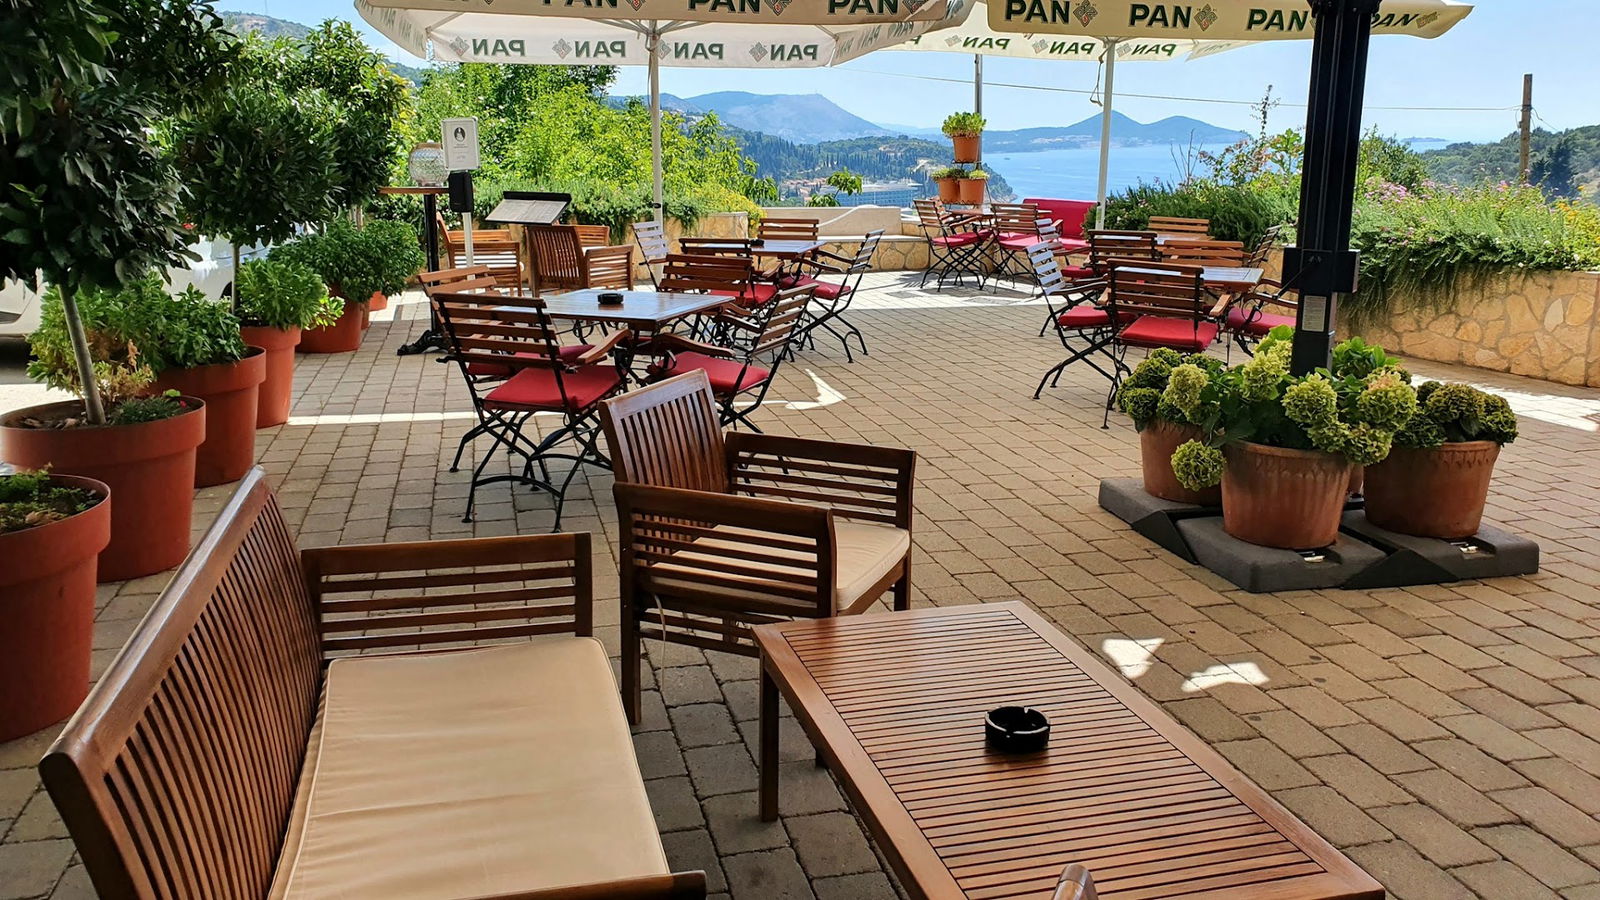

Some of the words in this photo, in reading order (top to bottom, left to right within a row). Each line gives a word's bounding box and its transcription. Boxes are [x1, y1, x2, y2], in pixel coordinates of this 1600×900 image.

[1005, 0, 1070, 24] PAN
[1128, 4, 1192, 28] PAN
[1245, 8, 1309, 31] PAN
